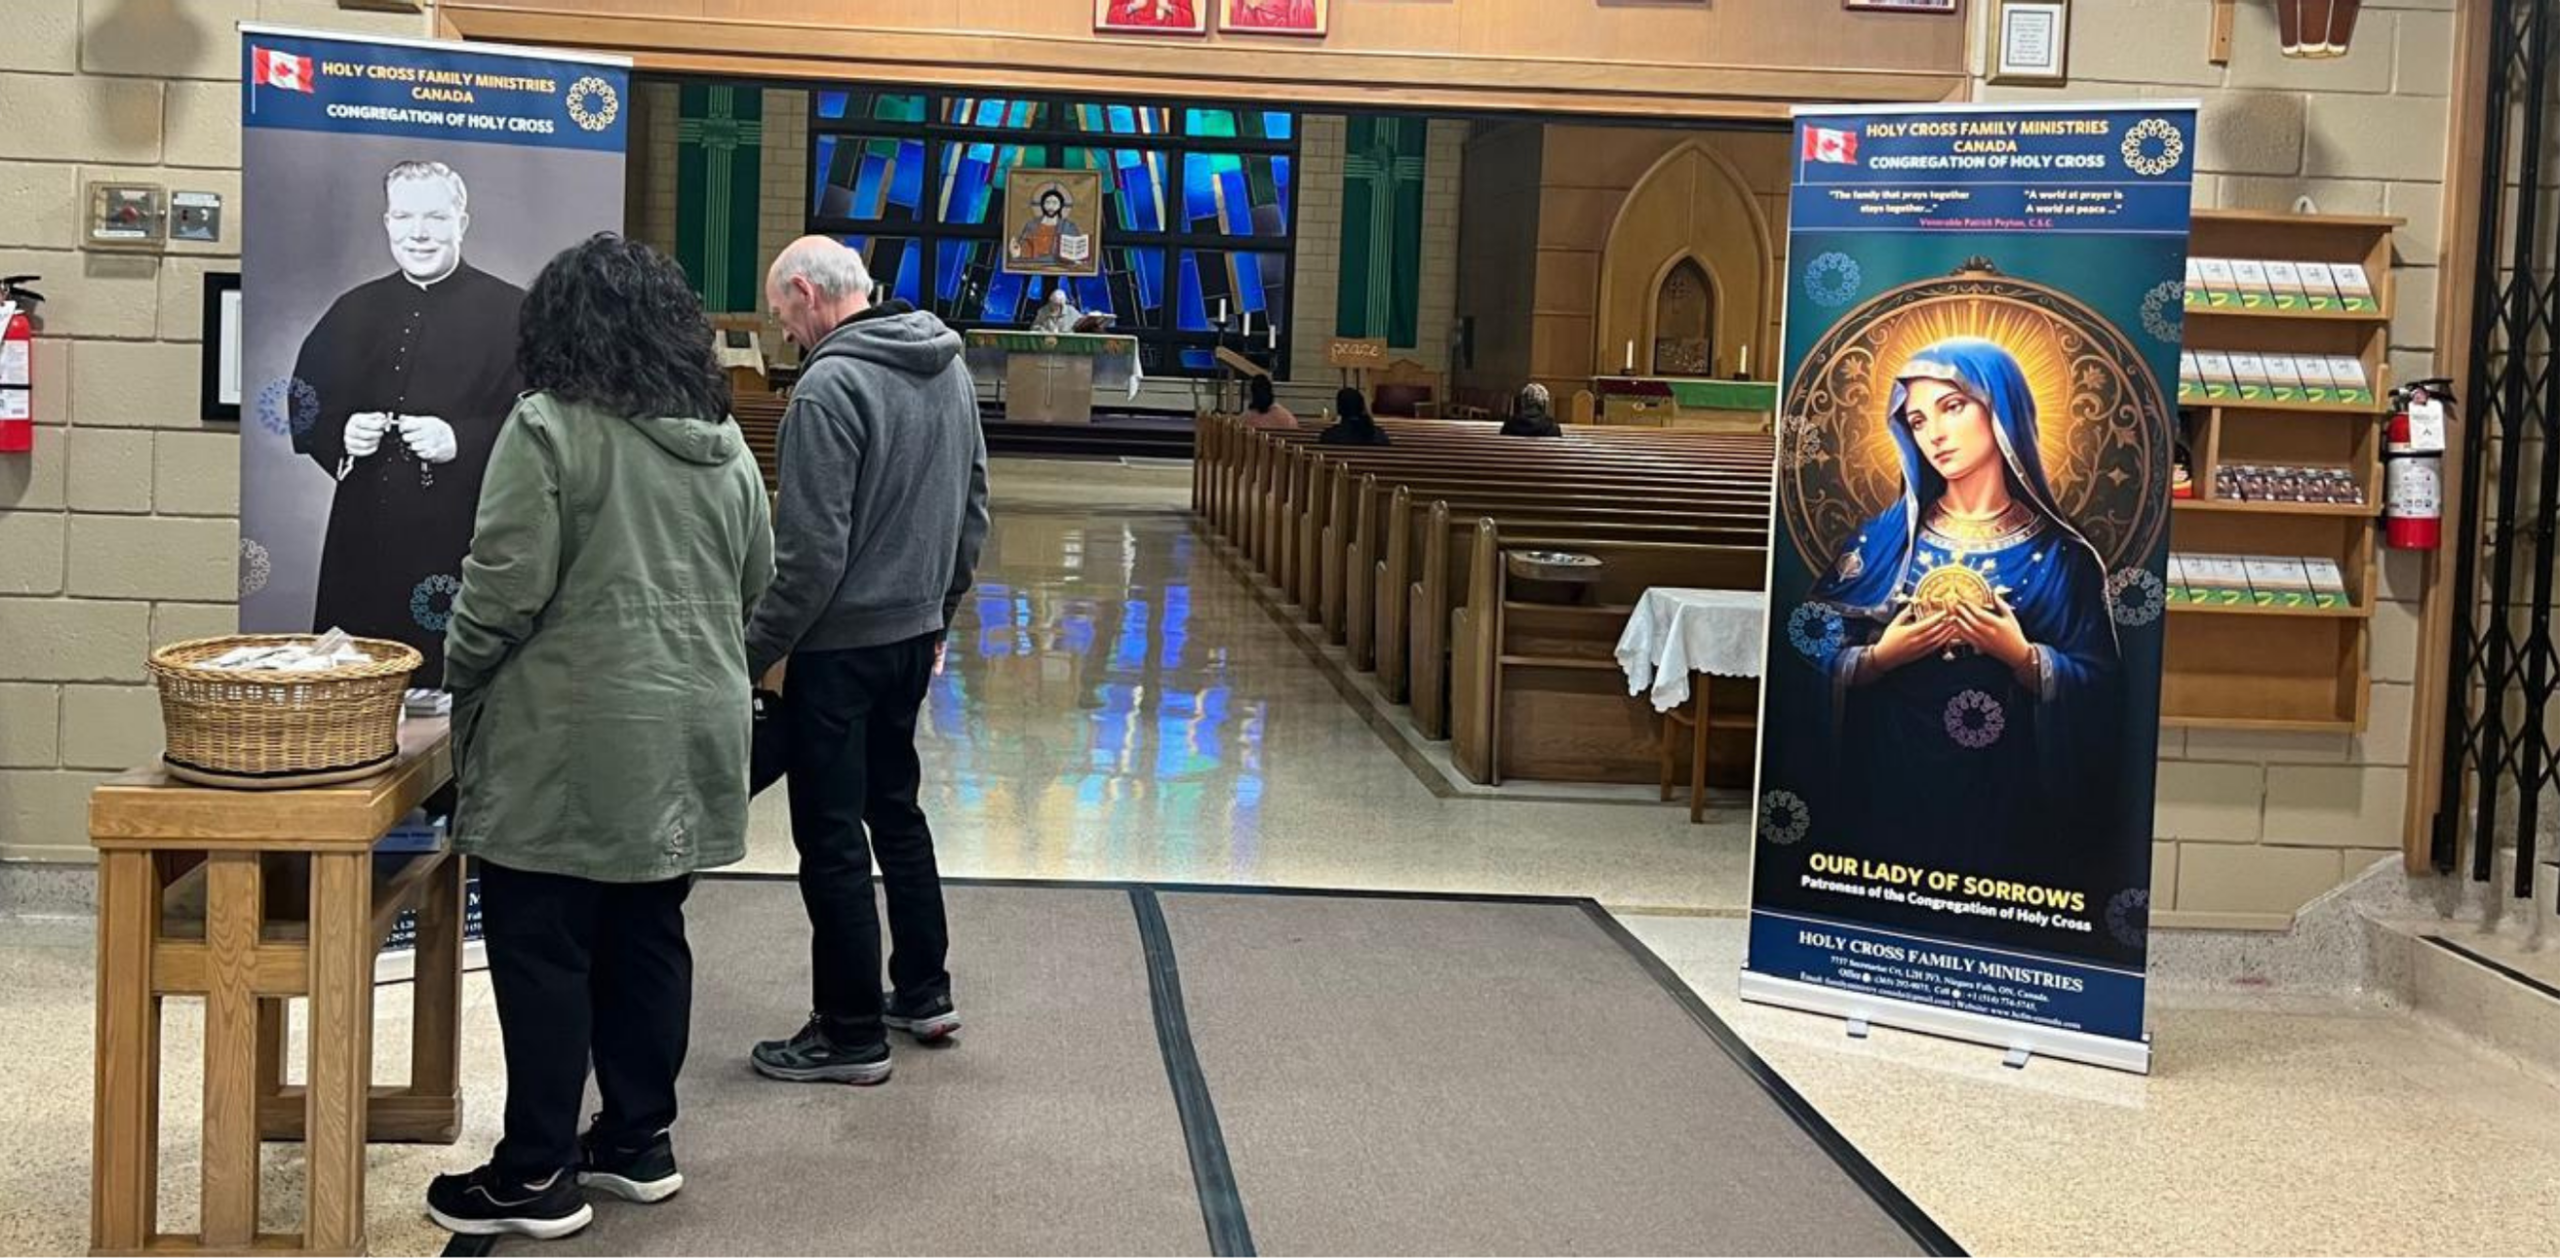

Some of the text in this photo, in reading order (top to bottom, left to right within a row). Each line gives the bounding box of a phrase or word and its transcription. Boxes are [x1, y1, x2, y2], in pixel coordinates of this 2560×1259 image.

[322, 61, 556, 93] HOLY CROSS FAMILY MINISTRIES
[411, 86, 475, 104] CANADA
[326, 104, 554, 133] CONGREGATION OF HOLY CROSS
[1866, 120, 2109, 137] HOLY CROSS FAMILY MINISTRIES
[1953, 140, 2018, 153] CANADA
[1869, 154, 2106, 170] CONGREGATION OF HOLY CROSS
[1853, 190, 1880, 201] family
[1881, 190, 1900, 199] that
[1930, 190, 1970, 201] together
[2038, 190, 2067, 199] world
[2068, 190, 2079, 199] at
[2080, 191, 2113, 201] prayer
[2025, 204, 2034, 213] A
[2035, 204, 2063, 213] world
[2065, 204, 2075, 213] at
[2076, 205, 2106, 215] peace
[1331, 343, 1379, 362] peace
[1809, 853, 2086, 912] OUR LADY OF SORROWS
[1801, 874, 2092, 932] Patroness of the Congregation of Holy Cross
[1799, 930, 2084, 993] HOLY CROSS FAMILY MINISTRIES
